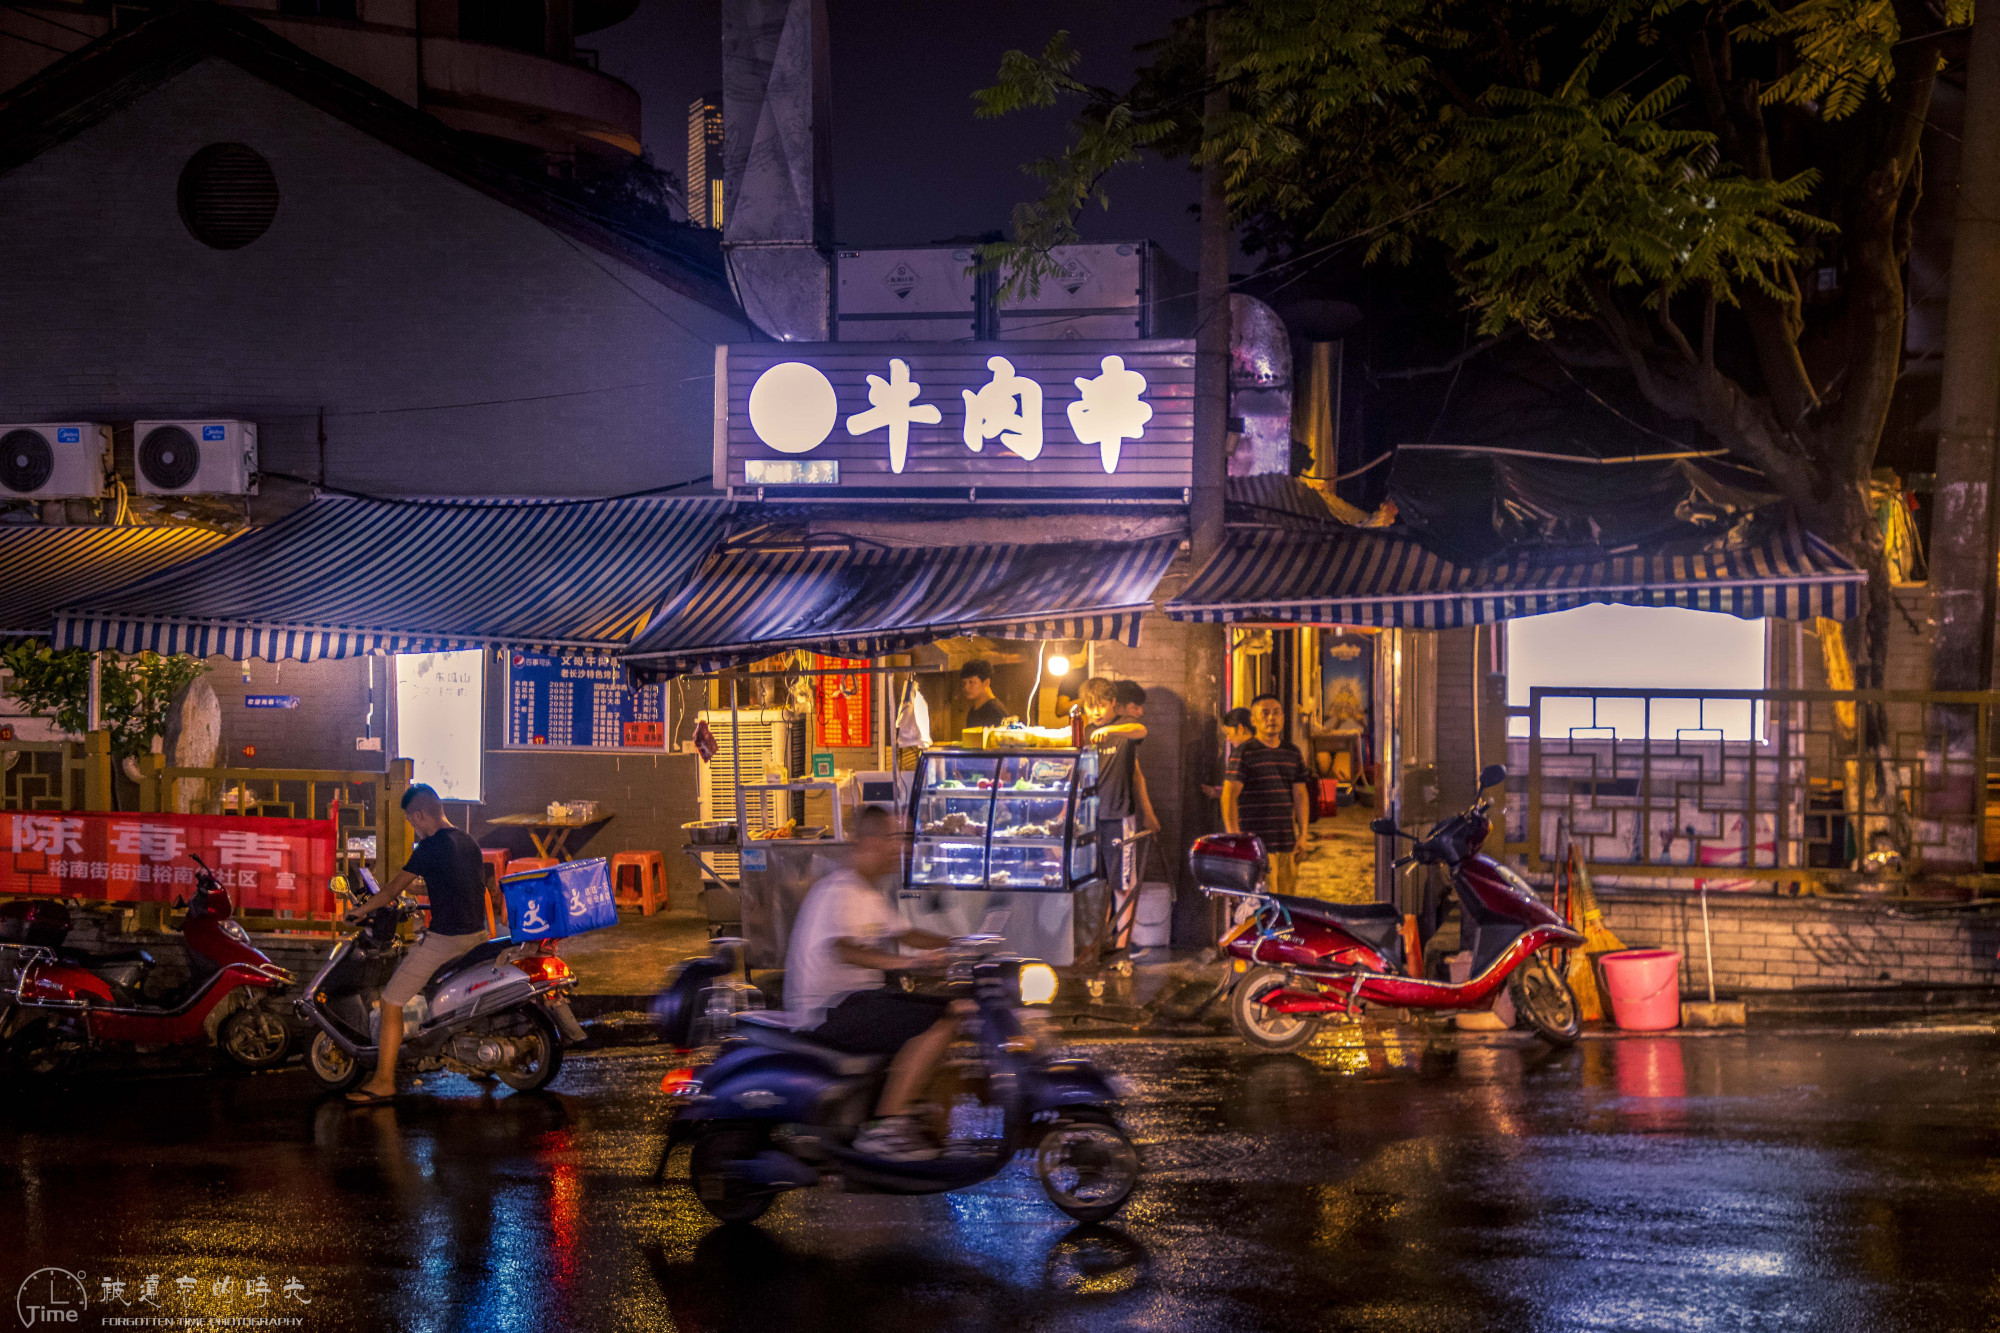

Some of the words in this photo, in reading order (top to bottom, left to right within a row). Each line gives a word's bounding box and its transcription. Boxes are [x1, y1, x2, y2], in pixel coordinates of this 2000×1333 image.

[845, 354, 1154, 474] 牛肉串
[526, 658, 551, 667] 百事可乐
[1, 729, 11, 739] 13
[276, 871, 297, 890] 宣
